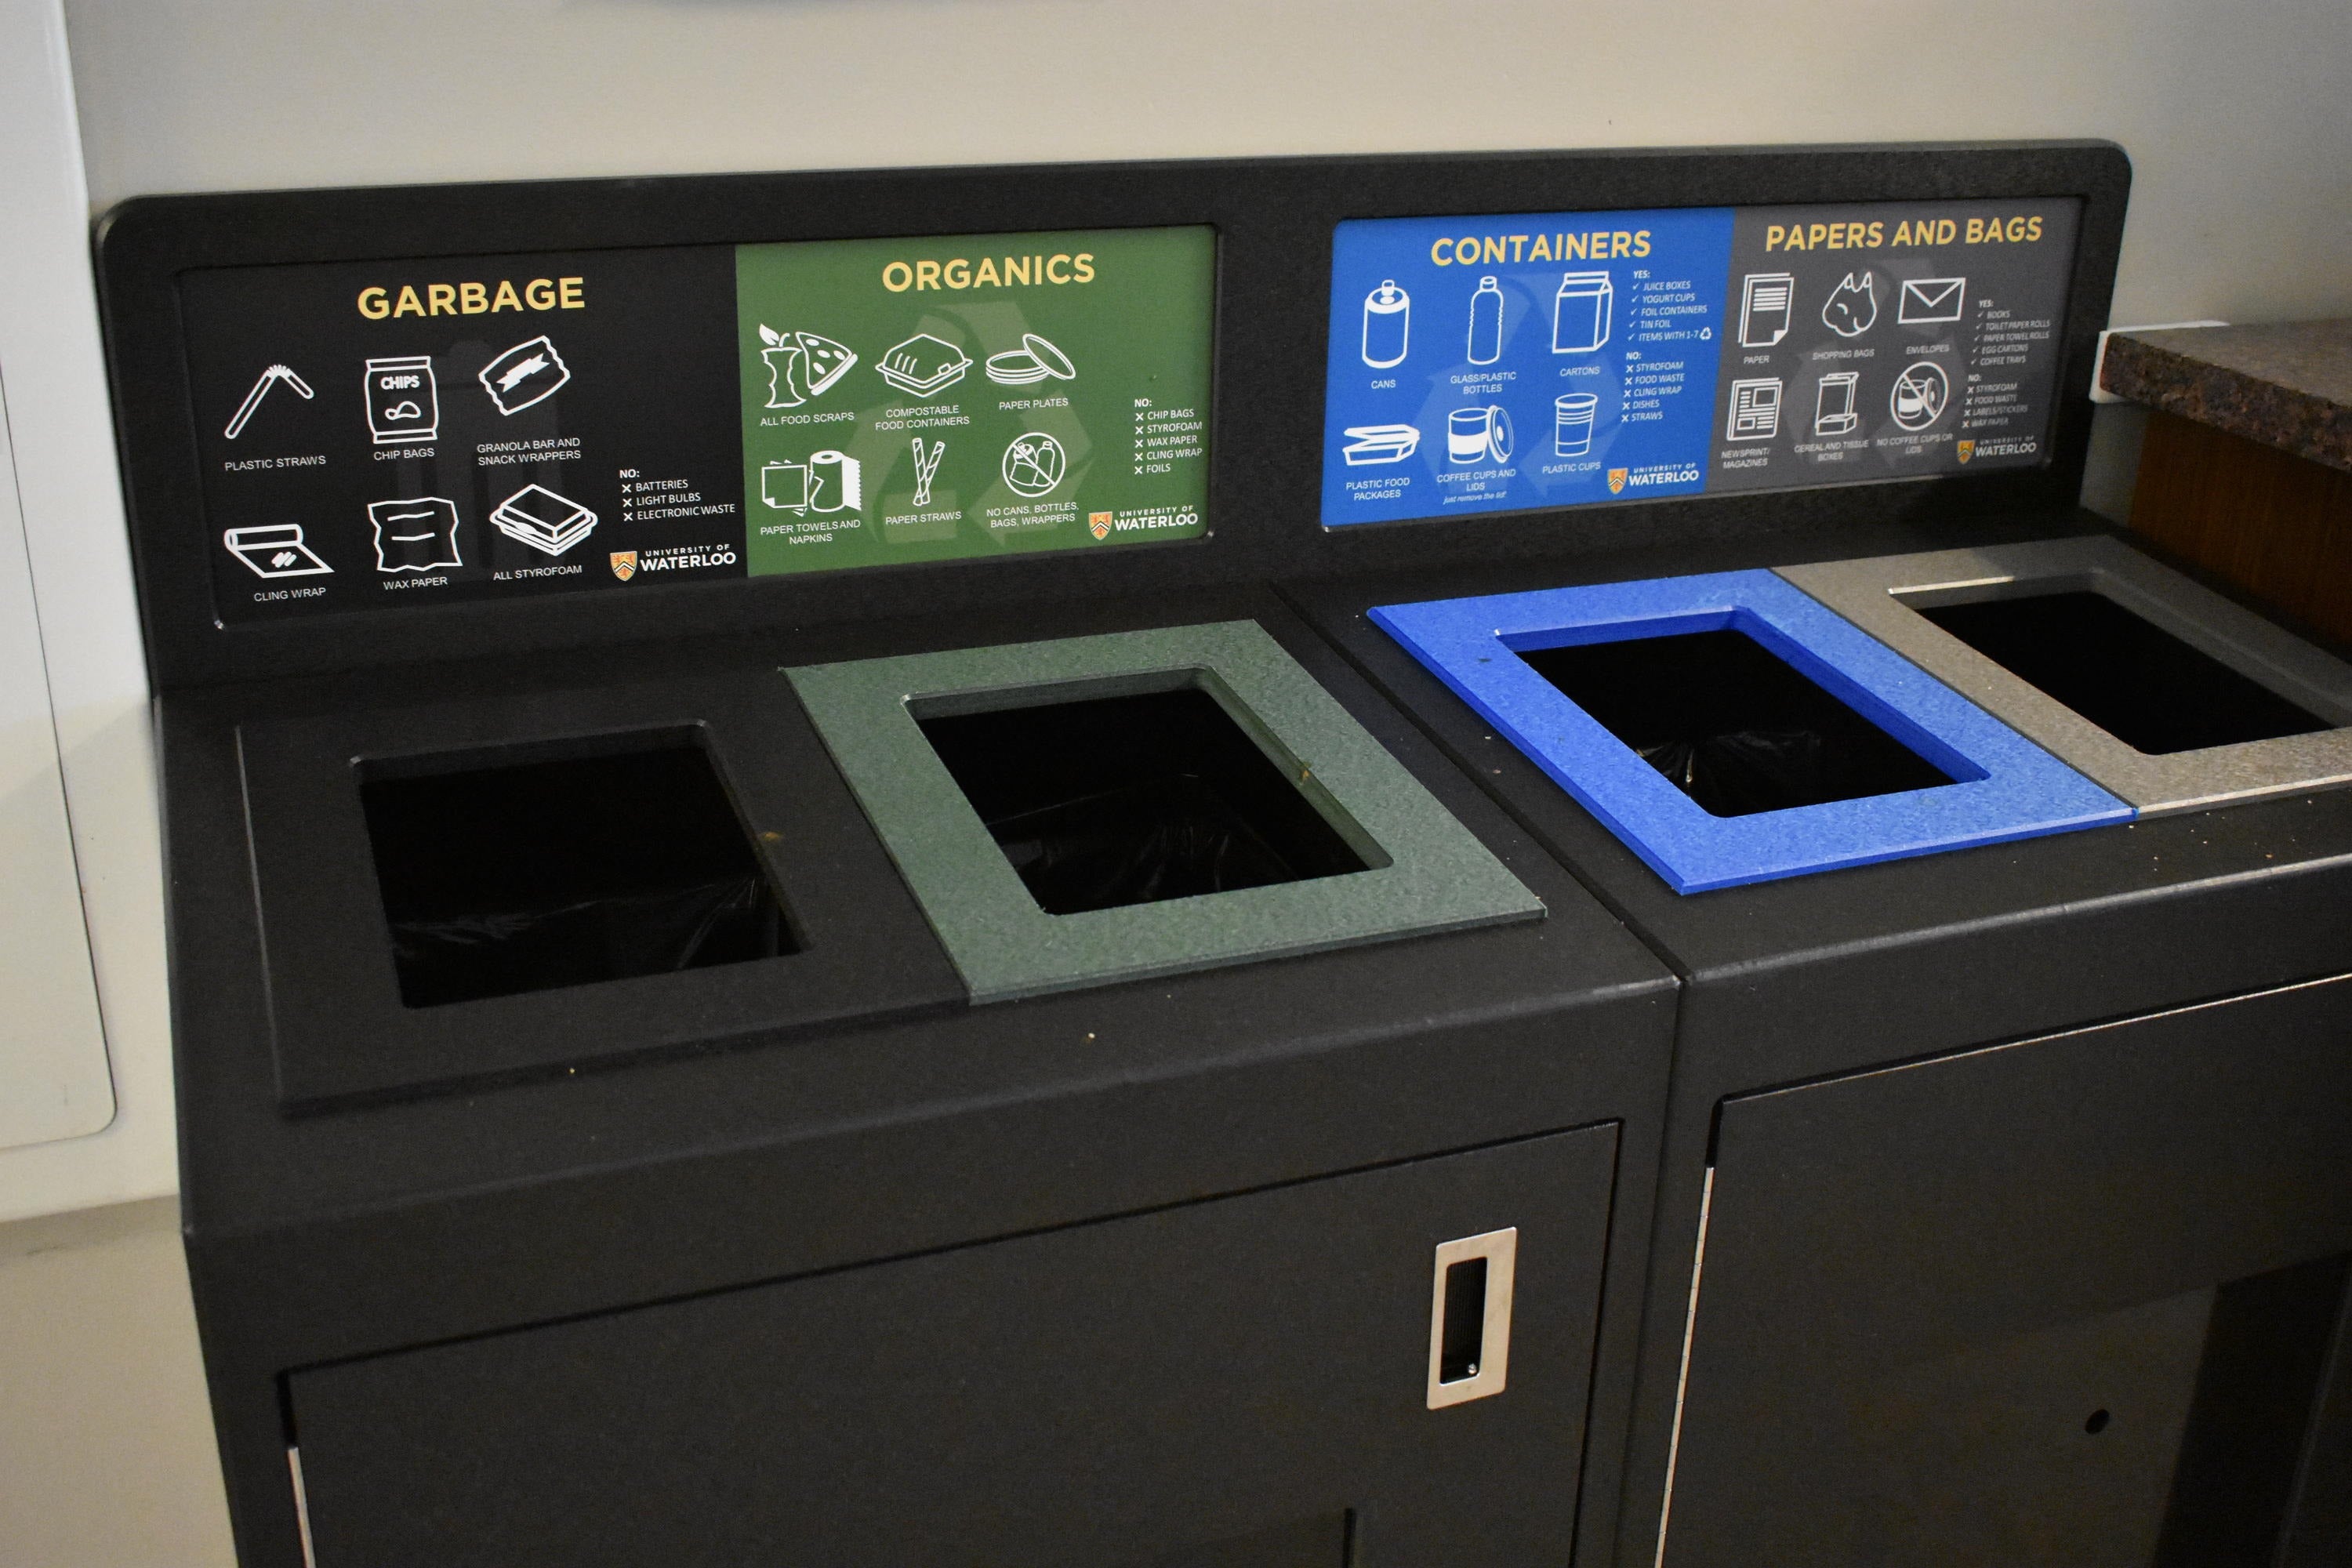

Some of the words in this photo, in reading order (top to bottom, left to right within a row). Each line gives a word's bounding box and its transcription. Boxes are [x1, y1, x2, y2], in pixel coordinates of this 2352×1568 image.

[1766, 222, 1883, 252] PAPERS
[1891, 219, 1957, 248] AND
[1965, 216, 2043, 244] BAGS
[1431, 230, 1651, 267] CONTAINERS
[882, 253, 1095, 292] ORGANICS
[1633, 270, 1651, 279] YES:
[1643, 282, 1664, 292] JUICE
[1665, 281, 1691, 290] BOXES
[358, 277, 585, 320] GARBAGE
[1642, 294, 1675, 303] YOGURT
[1675, 292, 1696, 302] CUPS
[1979, 299, 1994, 308] YES:
[1641, 307, 1658, 316] FOIL
[1659, 305, 1708, 315] CONTAINERS
[1640, 320, 1653, 328] TIN
[1654, 319, 1671, 328] FOIL
[1639, 332, 1663, 342] ITEMS
[1664, 331, 1686, 340] WITH
[1686, 330, 1699, 339] 1-7
[1812, 350, 1853, 361] SHOPPING
[1853, 349, 1875, 358] BAGS
[1906, 344, 1950, 354] ENVELOPES
[1626, 351, 1642, 361] NO:
[1743, 355, 1770, 365] PAPER
[1559, 366, 1600, 377] CARTONS
[1636, 361, 1684, 372] STYROFOAM
[380, 376, 419, 390] CHIPS
[1450, 371, 1517, 384] GLASS/PLASTIC
[1635, 375, 1657, 384] FOOD
[1658, 373, 1685, 383] WASTE
[1371, 379, 1396, 390] CANS
[1463, 384, 1503, 394] BOTTLES
[1633, 387, 1657, 397] CLING
[1658, 386, 1682, 395] WRAP
[999, 400, 1030, 410] PAPER
[1033, 397, 1069, 408] PLATES
[1134, 398, 1152, 407] NO:
[1632, 400, 1660, 409] DISHES
[885, 405, 960, 418] COMPOSTABLE
[1147, 411, 1169, 420] CHIP
[1171, 408, 1194, 418] BAGS
[1632, 412, 1664, 422] STRAWS
[760, 417, 780, 427] ALL
[782, 415, 811, 425] FOOD
[813, 412, 855, 423] SCRAPS
[875, 419, 905, 430] FOOD
[906, 416, 970, 428] CONTAINERS
[1147, 422, 1203, 434] STYROFOAM
[477, 441, 531, 452] GRANOLA
[533, 439, 554, 449] BAR
[557, 437, 580, 448] AND
[1147, 437, 1168, 447] WAX
[1170, 435, 1198, 445] PAPER
[1889, 436, 1919, 445] COFFEE
[1920, 434, 1940, 443] CUPS
[1794, 443, 1824, 453] CEREAL
[1824, 441, 1842, 450] AND
[1842, 440, 1869, 449] TISSUE
[1975, 441, 2037, 457] WATERLOO
[373, 450, 401, 461] CHIP
[403, 448, 435, 459] BAGS
[478, 455, 516, 466] SNACK
[518, 450, 581, 463] WRAPPERS
[1146, 450, 1174, 460] CLING
[1175, 448, 1203, 458] WRAP
[1817, 452, 1844, 462] BOXES
[225, 459, 273, 471] PLASTIC
[276, 456, 326, 467] STRAWS
[1146, 463, 1171, 474] FOILS
[1542, 463, 1579, 474] PLASTIC
[1580, 461, 1601, 471] CUPS
[1633, 464, 1682, 474] UNIVERSITY
[1722, 458, 1769, 470] MAGAZINES
[619, 469, 640, 478] NO:
[1436, 472, 1471, 483] COFFEE
[1473, 470, 1497, 481] CUPS
[1497, 469, 1516, 477] AND
[1628, 470, 1700, 486] WATERLOO
[636, 479, 688, 492] BATTERIES
[1345, 480, 1384, 491] PLASTIC
[1385, 477, 1410, 487] FOOD
[1466, 482, 1486, 492] LIDS
[637, 495, 666, 506] LIGHT
[669, 492, 701, 503] BULBS
[1354, 489, 1402, 501] PACKAGES
[1457, 493, 1483, 503] remove
[637, 506, 699, 521] ELECTRONIC
[700, 504, 735, 514] WASTE
[986, 508, 1001, 517] NO
[1034, 502, 1080, 514] BOTTLES,
[1120, 506, 1178, 517] UNIVERSITY
[885, 515, 918, 525] PAPER
[920, 511, 962, 522] STRAWS
[1022, 514, 1076, 525] WRAPPERS
[1115, 513, 1199, 532] WATERLOO
[760, 525, 793, 535] PAPER
[796, 521, 839, 532] TOWELS
[840, 519, 861, 528] AND
[789, 533, 833, 545] NAPKINS
[645, 545, 711, 557] UNIVERSITY
[640, 552, 736, 572] WATERLOO
[493, 571, 513, 581] ALL
[515, 565, 583, 579] STYROFOAM
[383, 579, 409, 590] WAX
[412, 576, 448, 588] PAPER
[254, 590, 289, 602] CLING
[291, 587, 326, 599] WRAP
